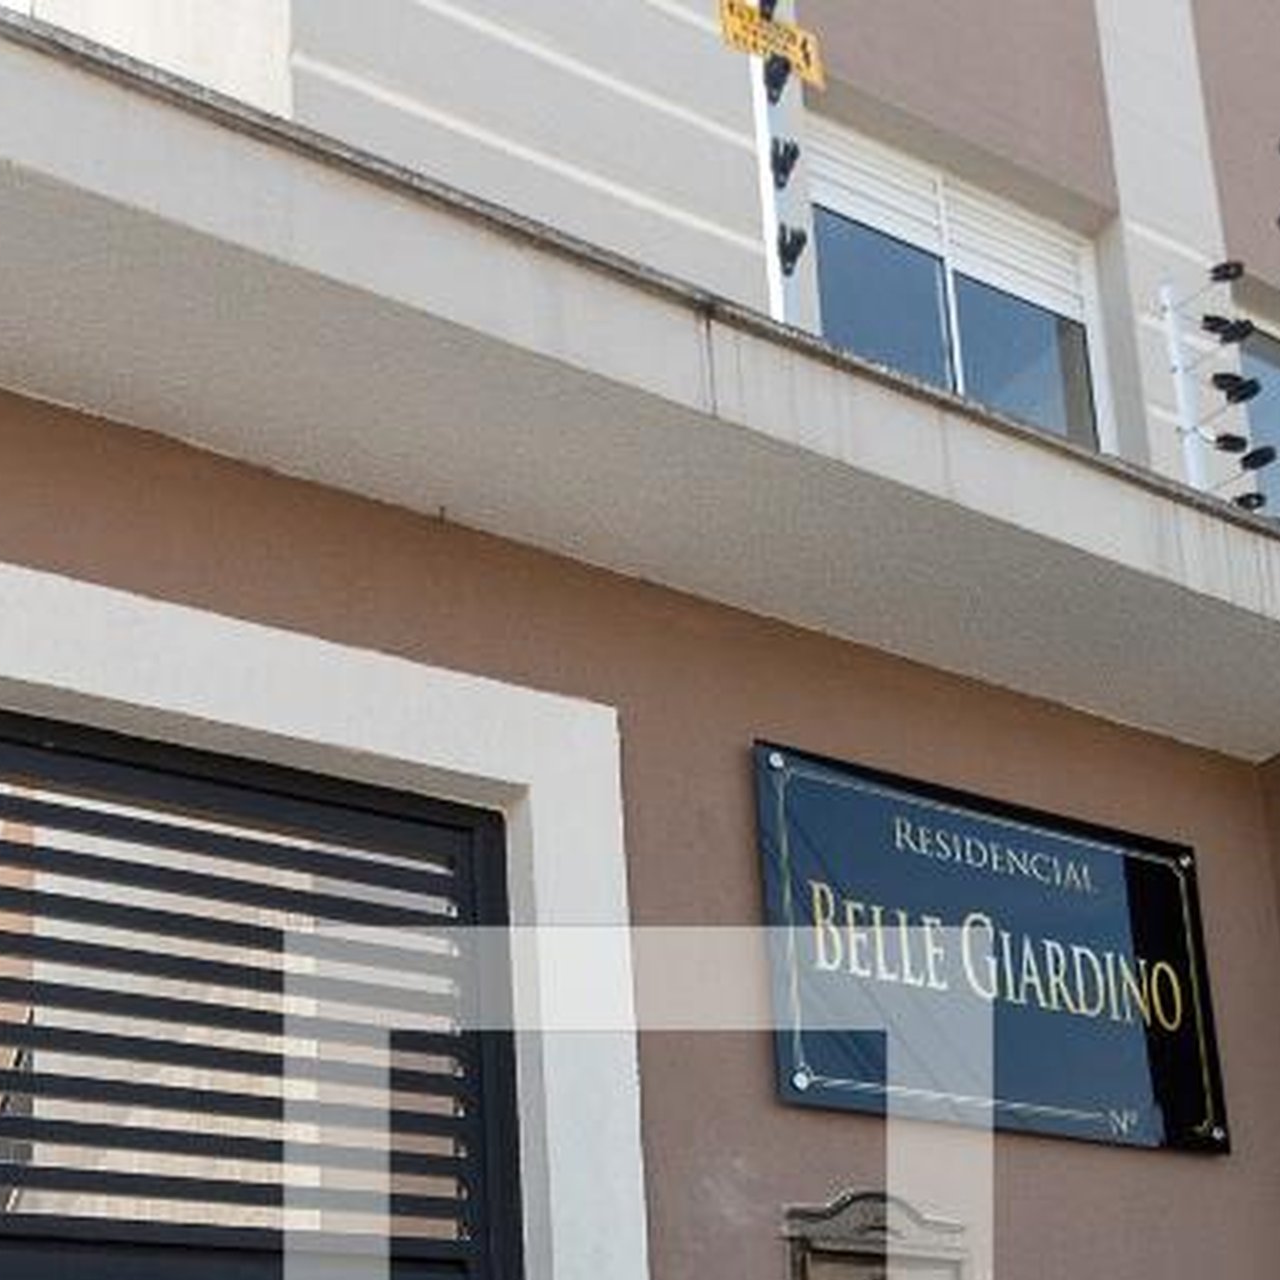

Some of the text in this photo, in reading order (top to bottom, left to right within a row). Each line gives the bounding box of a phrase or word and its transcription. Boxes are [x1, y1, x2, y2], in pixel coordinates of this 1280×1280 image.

[893, 816, 1098, 893] RESIDENCIAL
[808, 879, 1183, 1033] BELLE GIARDINO
